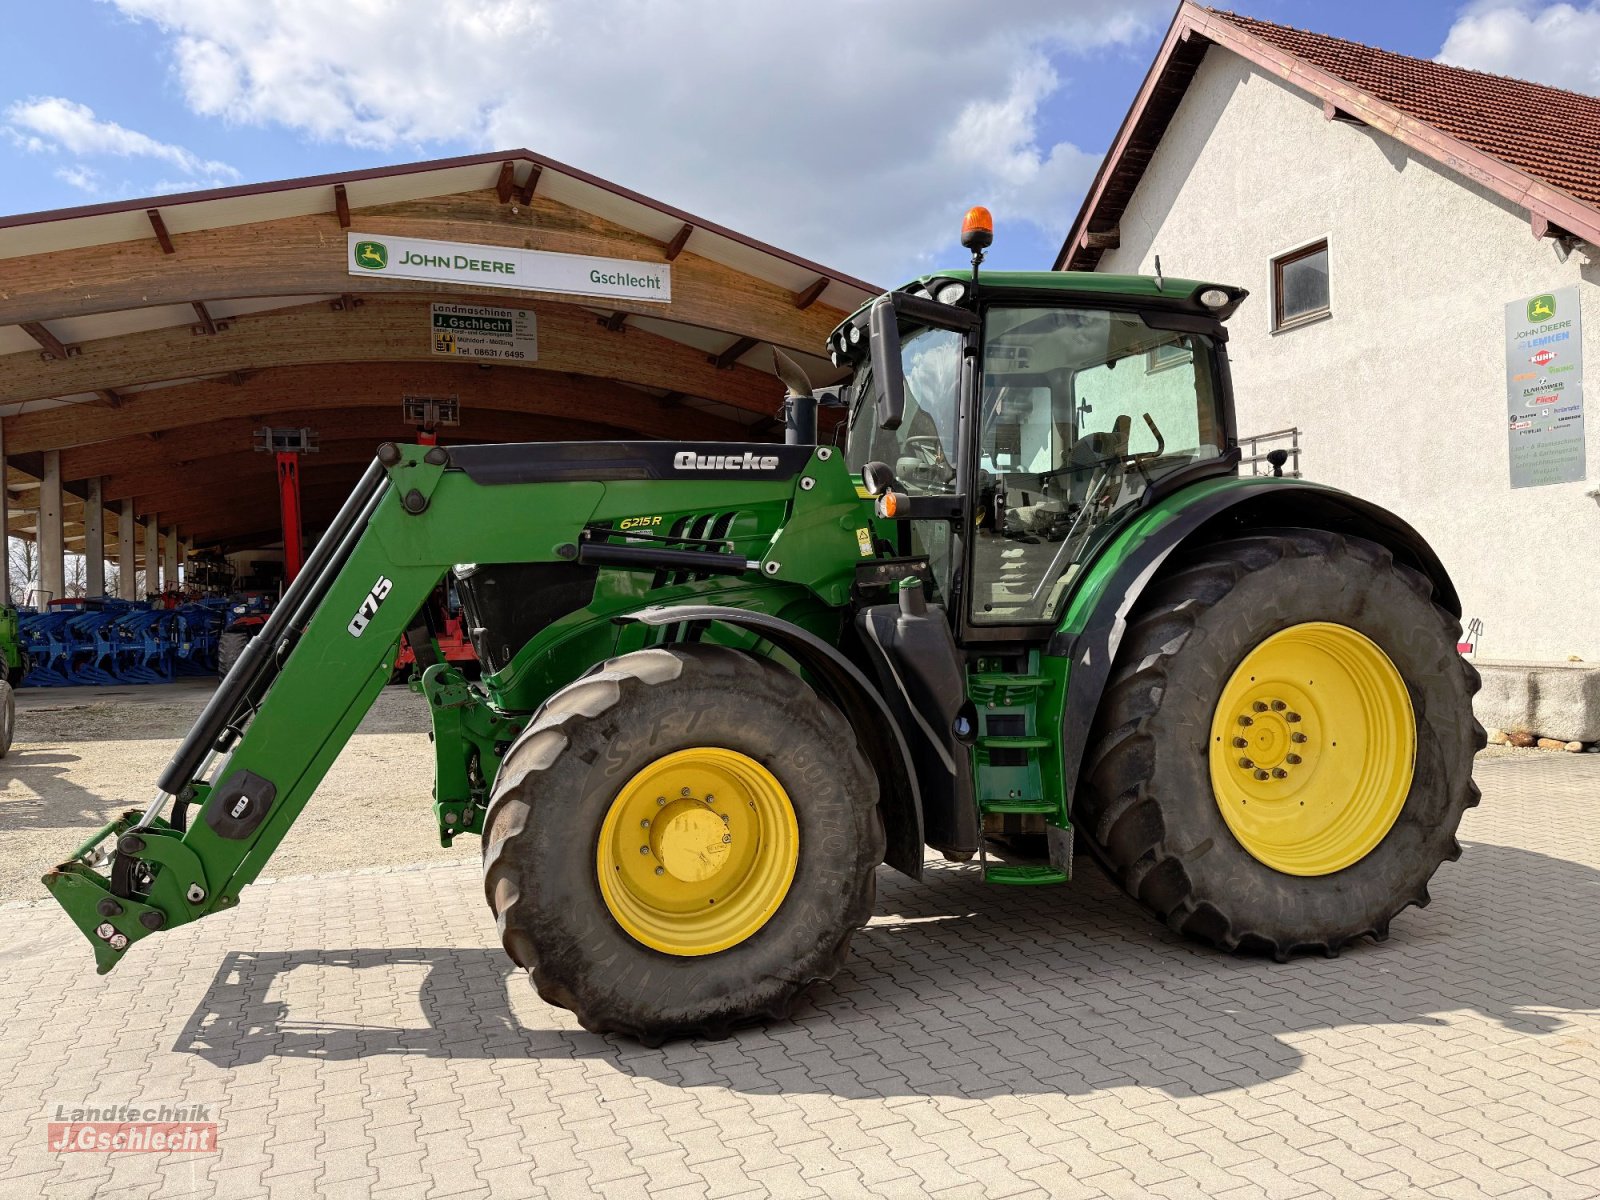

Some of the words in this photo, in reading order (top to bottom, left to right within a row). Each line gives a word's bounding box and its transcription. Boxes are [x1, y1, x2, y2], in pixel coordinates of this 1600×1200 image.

[399, 251, 450, 268] JOHN
[454, 256, 515, 274] DEERE
[590, 270, 661, 290] Gschlecht
[433, 304, 512, 317] Landmaschinen
[436, 317, 446, 327] J.
[449, 317, 510, 331] Gschlecht
[1514, 328, 1538, 340] JOHN
[1540, 320, 1571, 334] DEERE
[457, 347, 472, 355] Tel.
[504, 350, 525, 359] 6495
[1530, 352, 1555, 363] KUHN
[673, 451, 779, 470] Quicke
